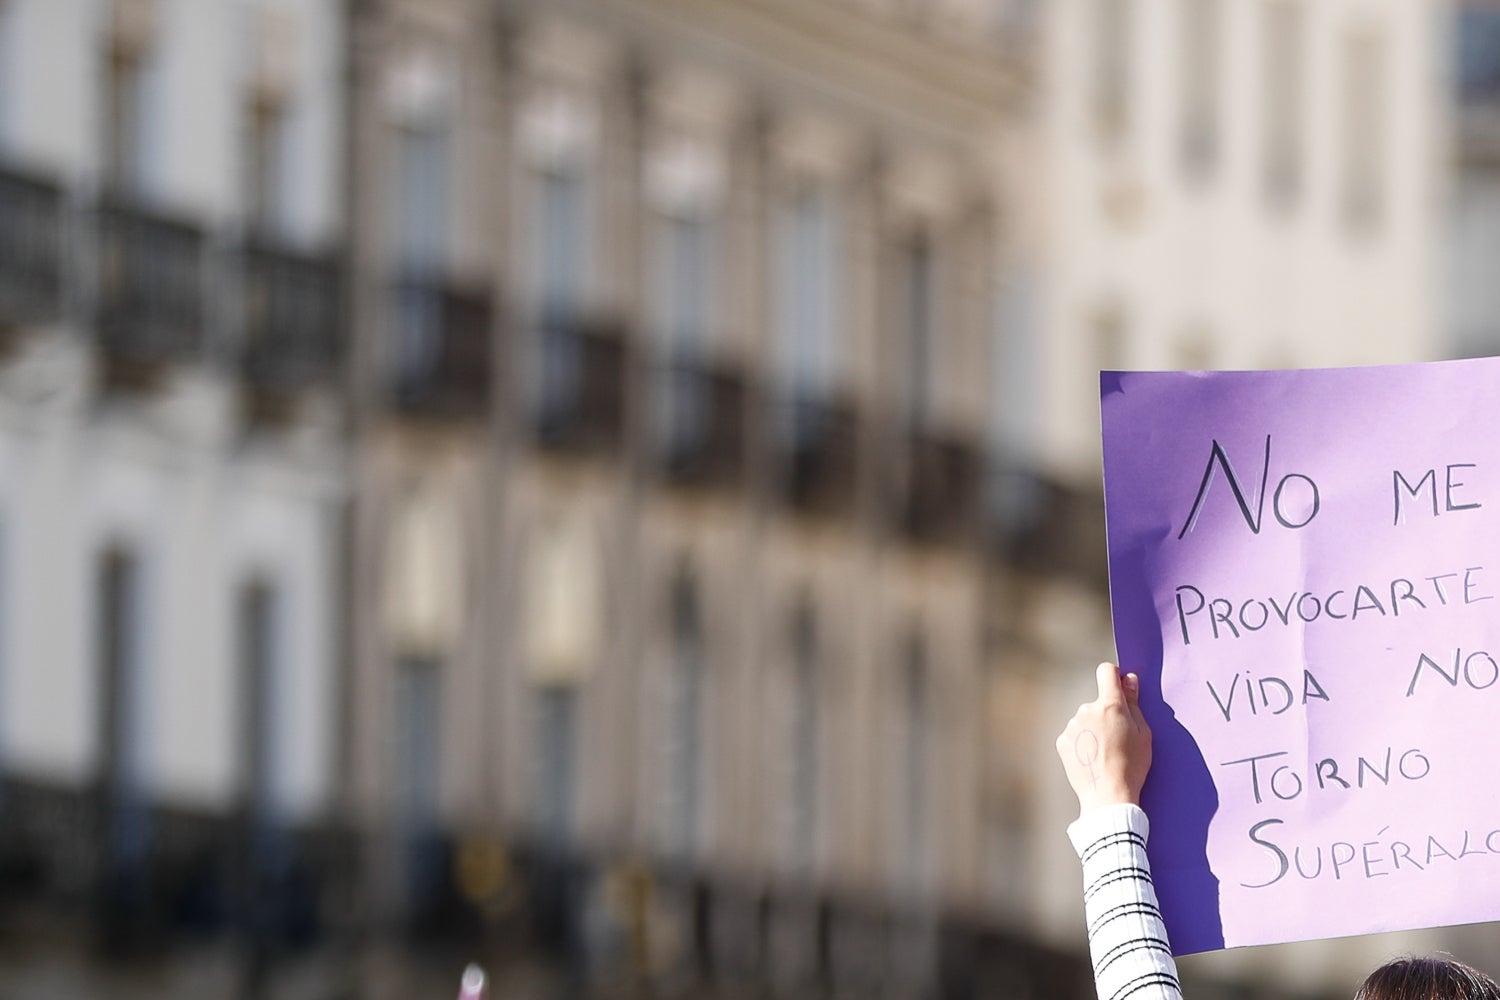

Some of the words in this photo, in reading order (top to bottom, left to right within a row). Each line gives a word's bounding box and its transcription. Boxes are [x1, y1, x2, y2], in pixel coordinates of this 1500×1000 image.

[1392, 463, 1482, 526] ME
[1175, 566, 1494, 644] PROVOCARTE
[1406, 647, 1499, 697] NO
[1219, 746, 1430, 804] TORNO
